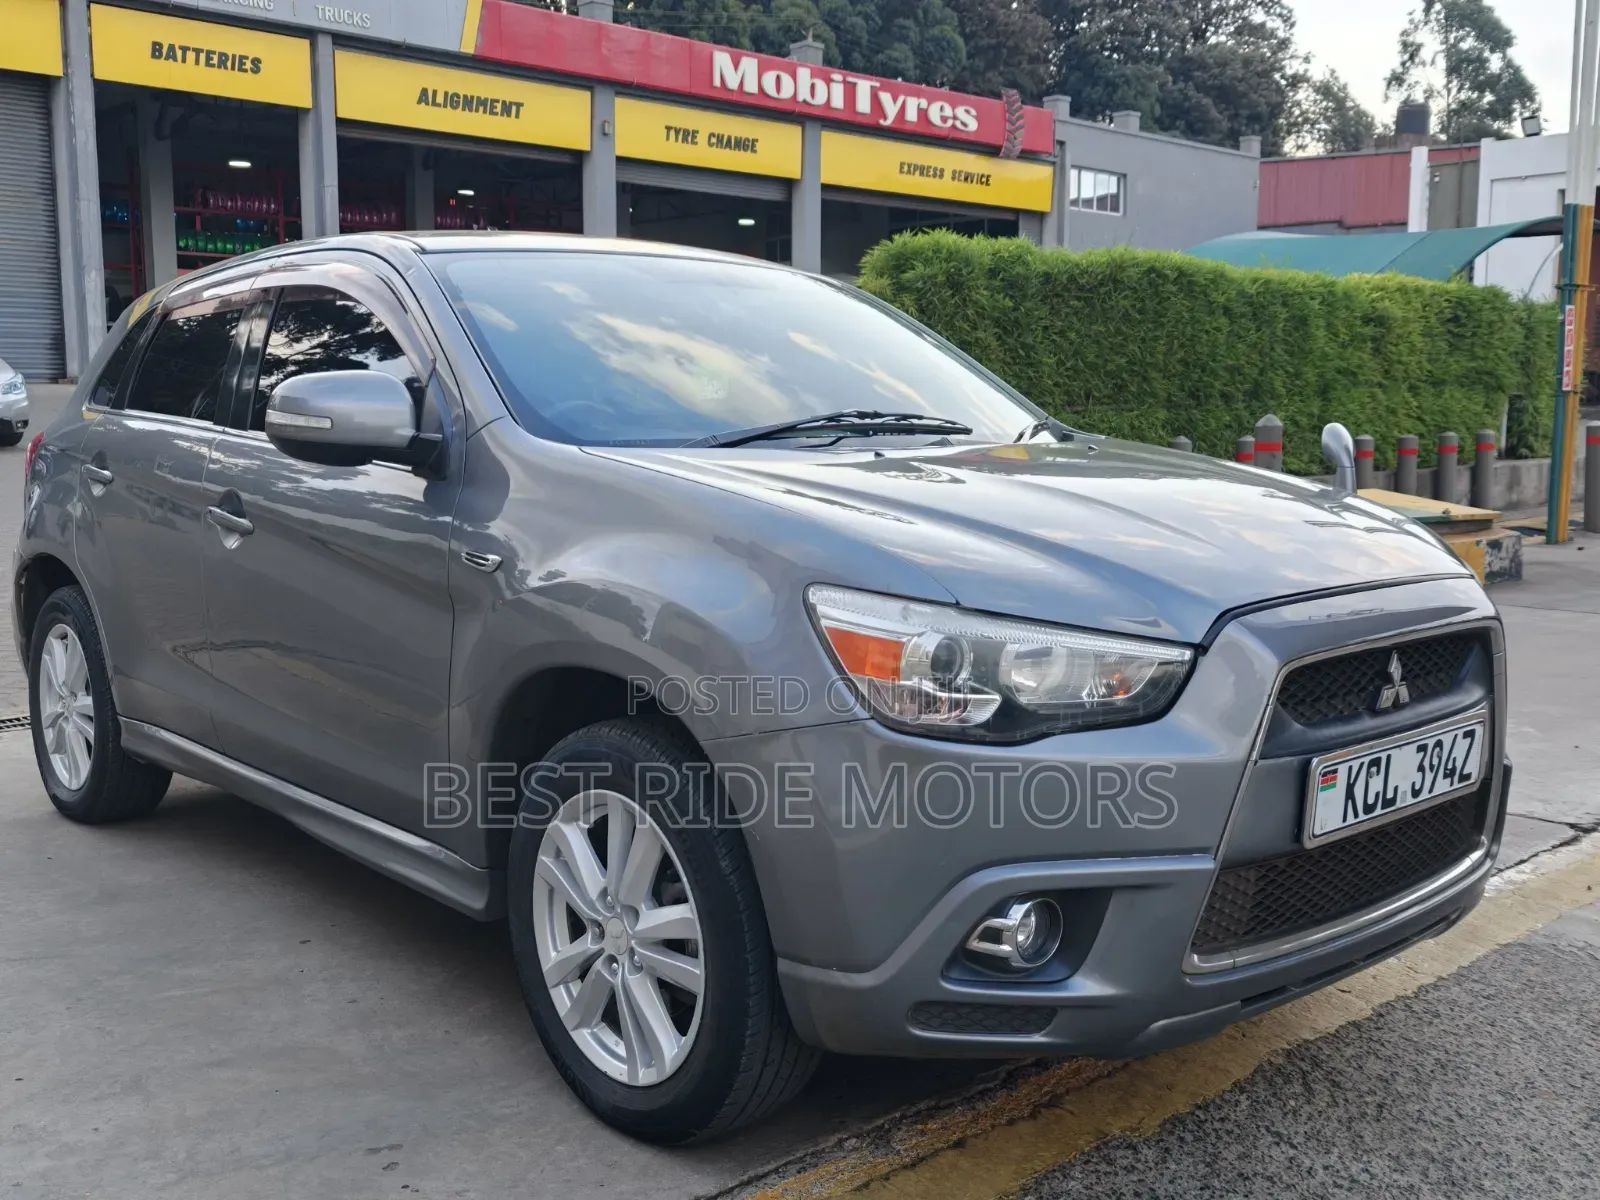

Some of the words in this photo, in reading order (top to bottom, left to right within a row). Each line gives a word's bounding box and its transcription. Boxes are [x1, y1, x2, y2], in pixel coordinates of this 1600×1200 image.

[315, 4, 371, 28] TRUCKS
[150, 40, 263, 75] BATTERIES
[416, 87, 525, 120] ALIGNMENT
[712, 50, 979, 132] MobiTyres
[664, 125, 700, 146] TYRE
[707, 132, 759, 154] CHANGE
[899, 161, 945, 180] EXPRESS
[951, 169, 992, 187] SERVICE
[1342, 753, 1399, 824] KCL
[1411, 728, 1476, 800] 394Z
